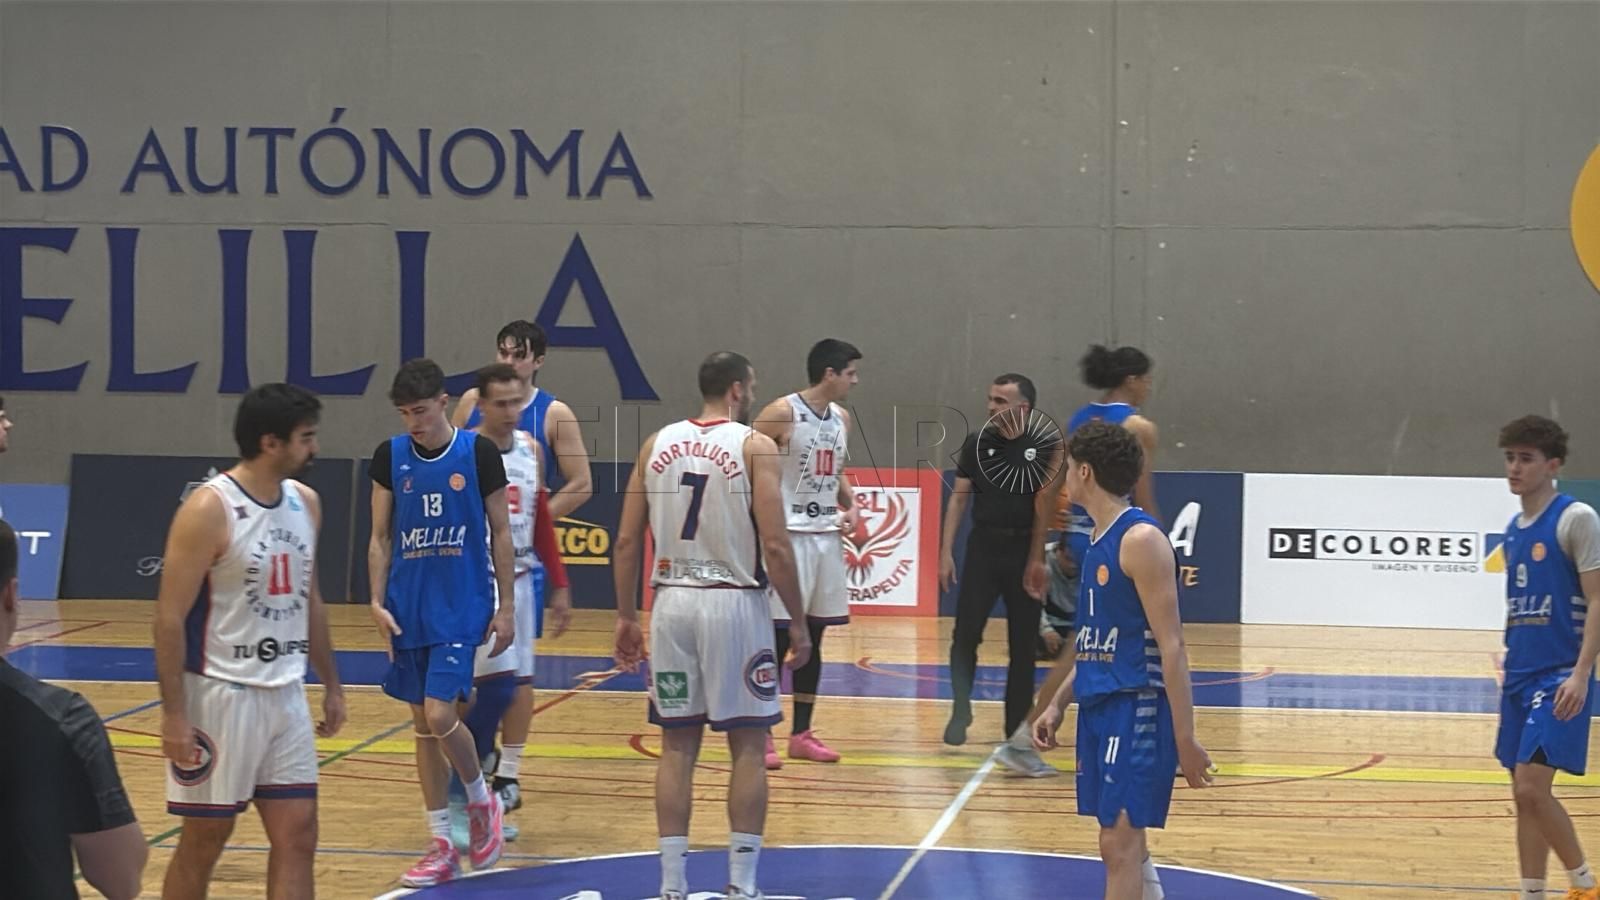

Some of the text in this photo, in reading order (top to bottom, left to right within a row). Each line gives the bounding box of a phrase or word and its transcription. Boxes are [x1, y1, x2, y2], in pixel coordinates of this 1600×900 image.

[120, 107, 653, 199] AUTÓNOMA
[651, 440, 743, 480] BORTOLUSSI
[422, 493, 444, 518] 13
[680, 471, 709, 541] 7
[401, 525, 467, 550] MELILLA
[267, 552, 293, 596] 11
[847, 559, 914, 602] RAPEUTA
[1104, 736, 1120, 765] 11
